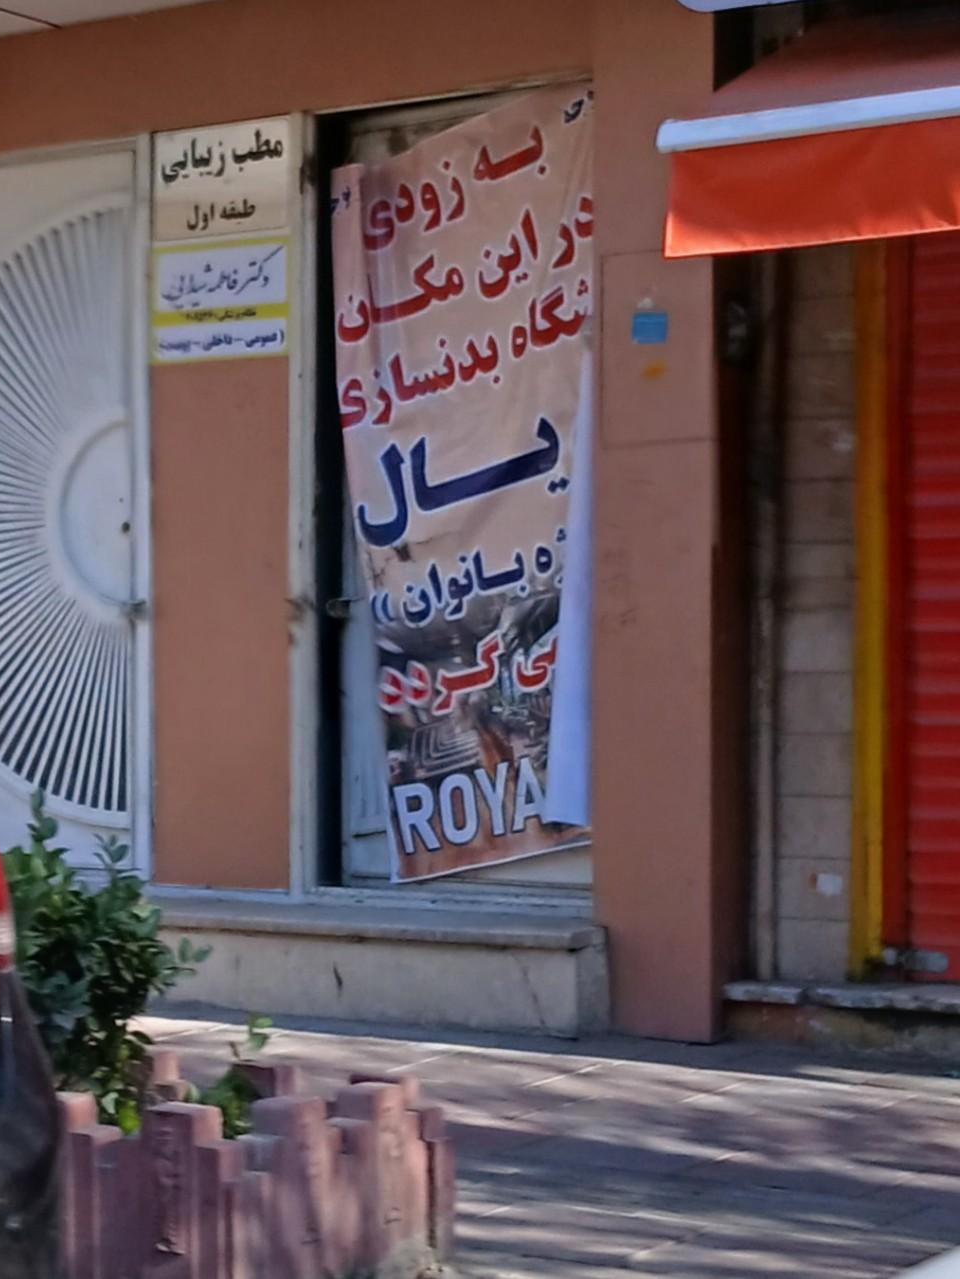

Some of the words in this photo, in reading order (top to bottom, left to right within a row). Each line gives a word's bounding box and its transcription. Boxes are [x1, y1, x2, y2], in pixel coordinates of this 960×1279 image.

[161, 137, 226, 184] زیبایی
[231, 128, 283, 172] مطب
[473, 125, 547, 182] به
[187, 202, 215, 231] اول
[219, 198, 257, 225] طبقه
[363, 160, 466, 251] زودی
[235, 245, 284, 295] دکتر
[479, 208, 538, 301] این
[510, 276, 590, 359] شگاه
[340, 332, 501, 428] بدنسازی
[357, 417, 573, 548] یال
[393, 755, 548, 855] ROYA
